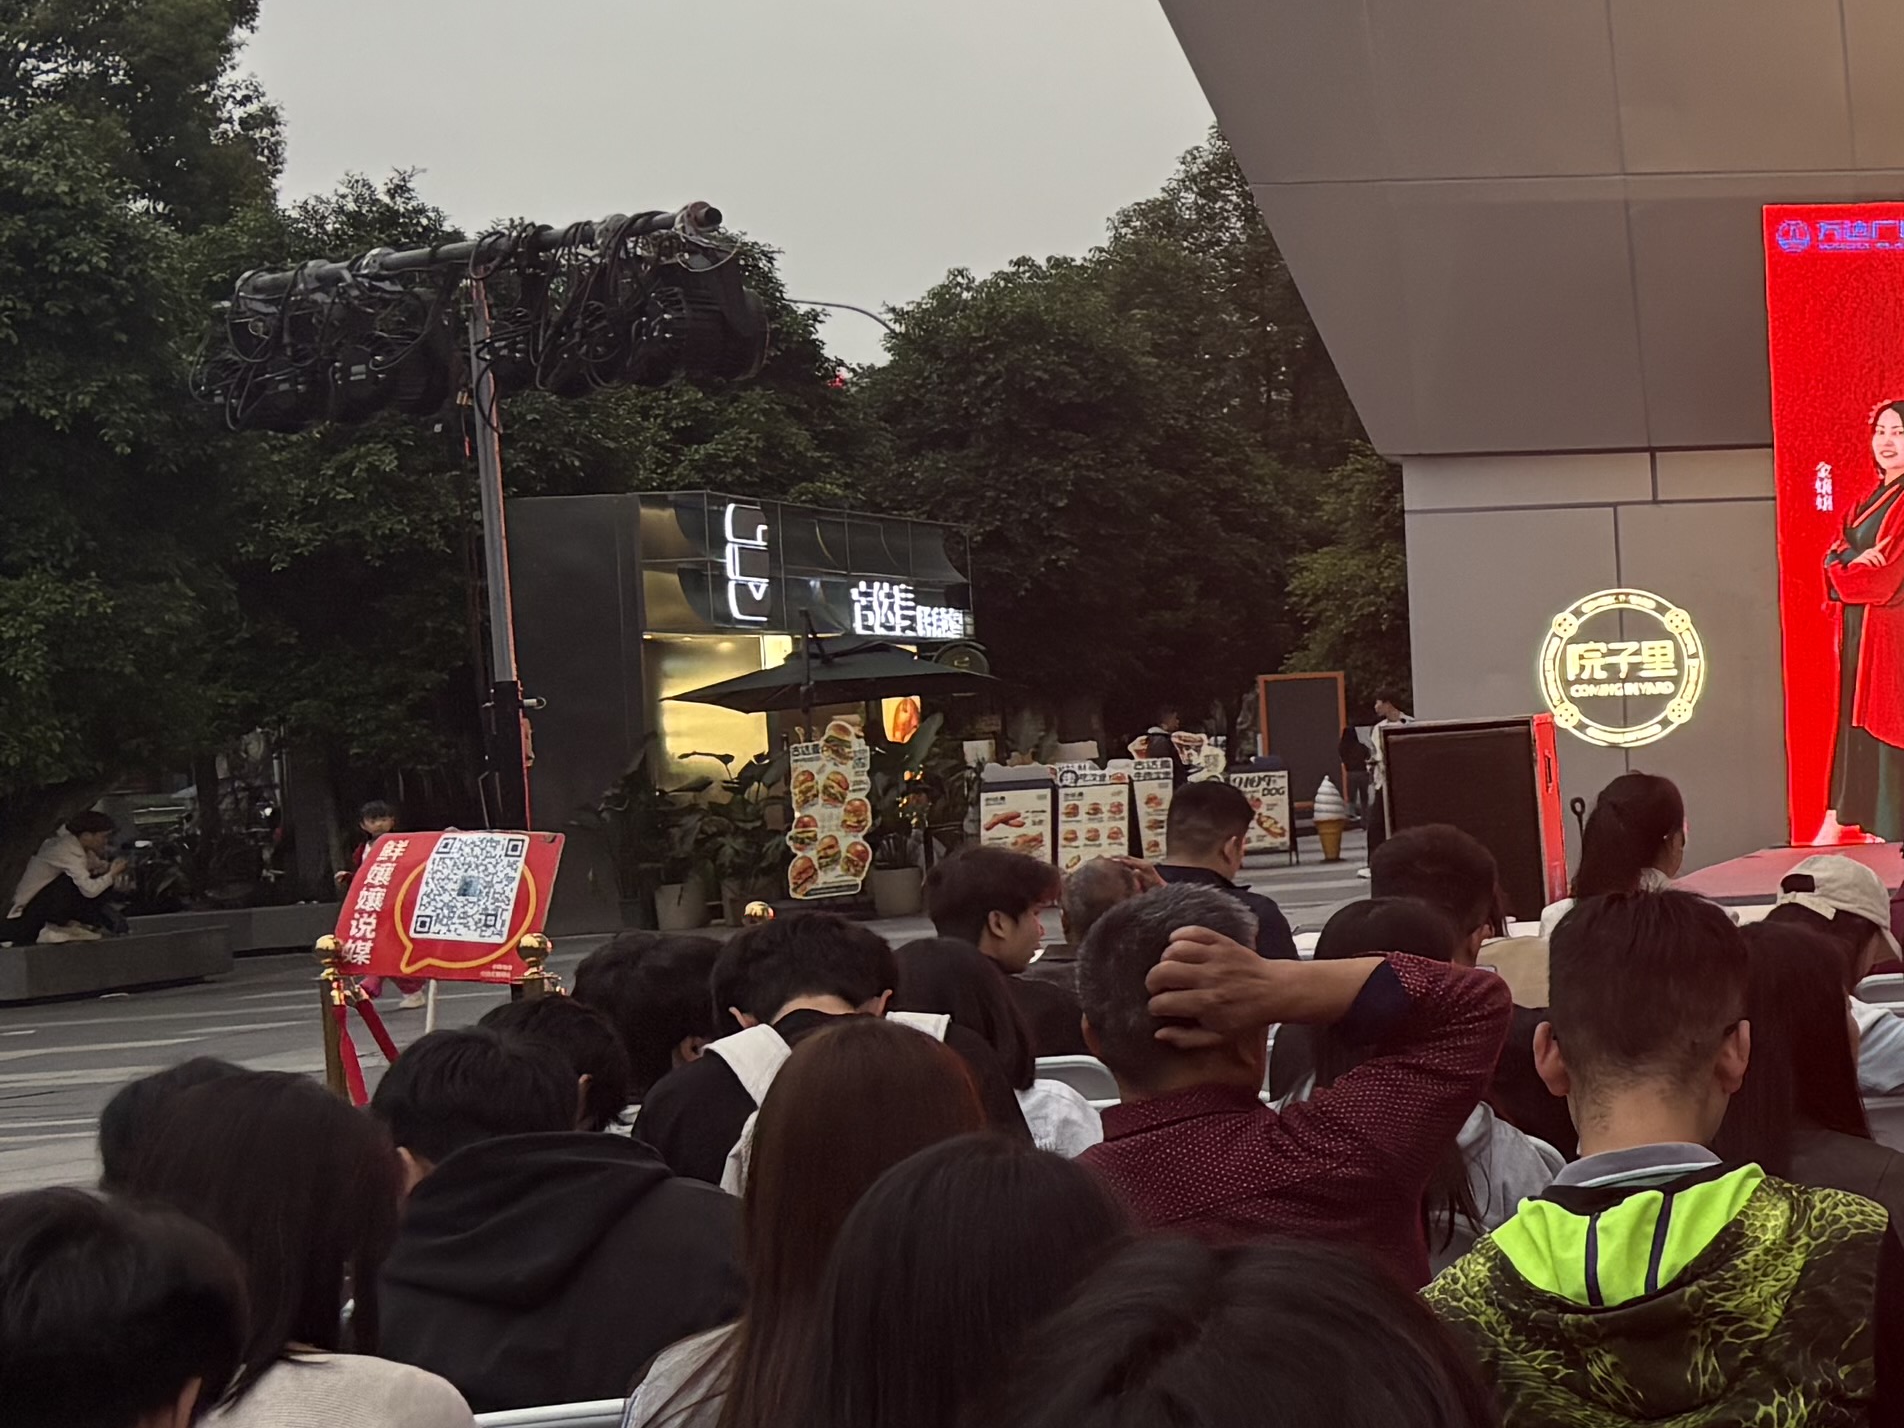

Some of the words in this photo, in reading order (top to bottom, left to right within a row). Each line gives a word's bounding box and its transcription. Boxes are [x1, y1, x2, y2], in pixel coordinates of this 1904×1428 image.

[1566, 639, 1678, 681] 院子里
[1262, 786, 1286, 796] DOG
